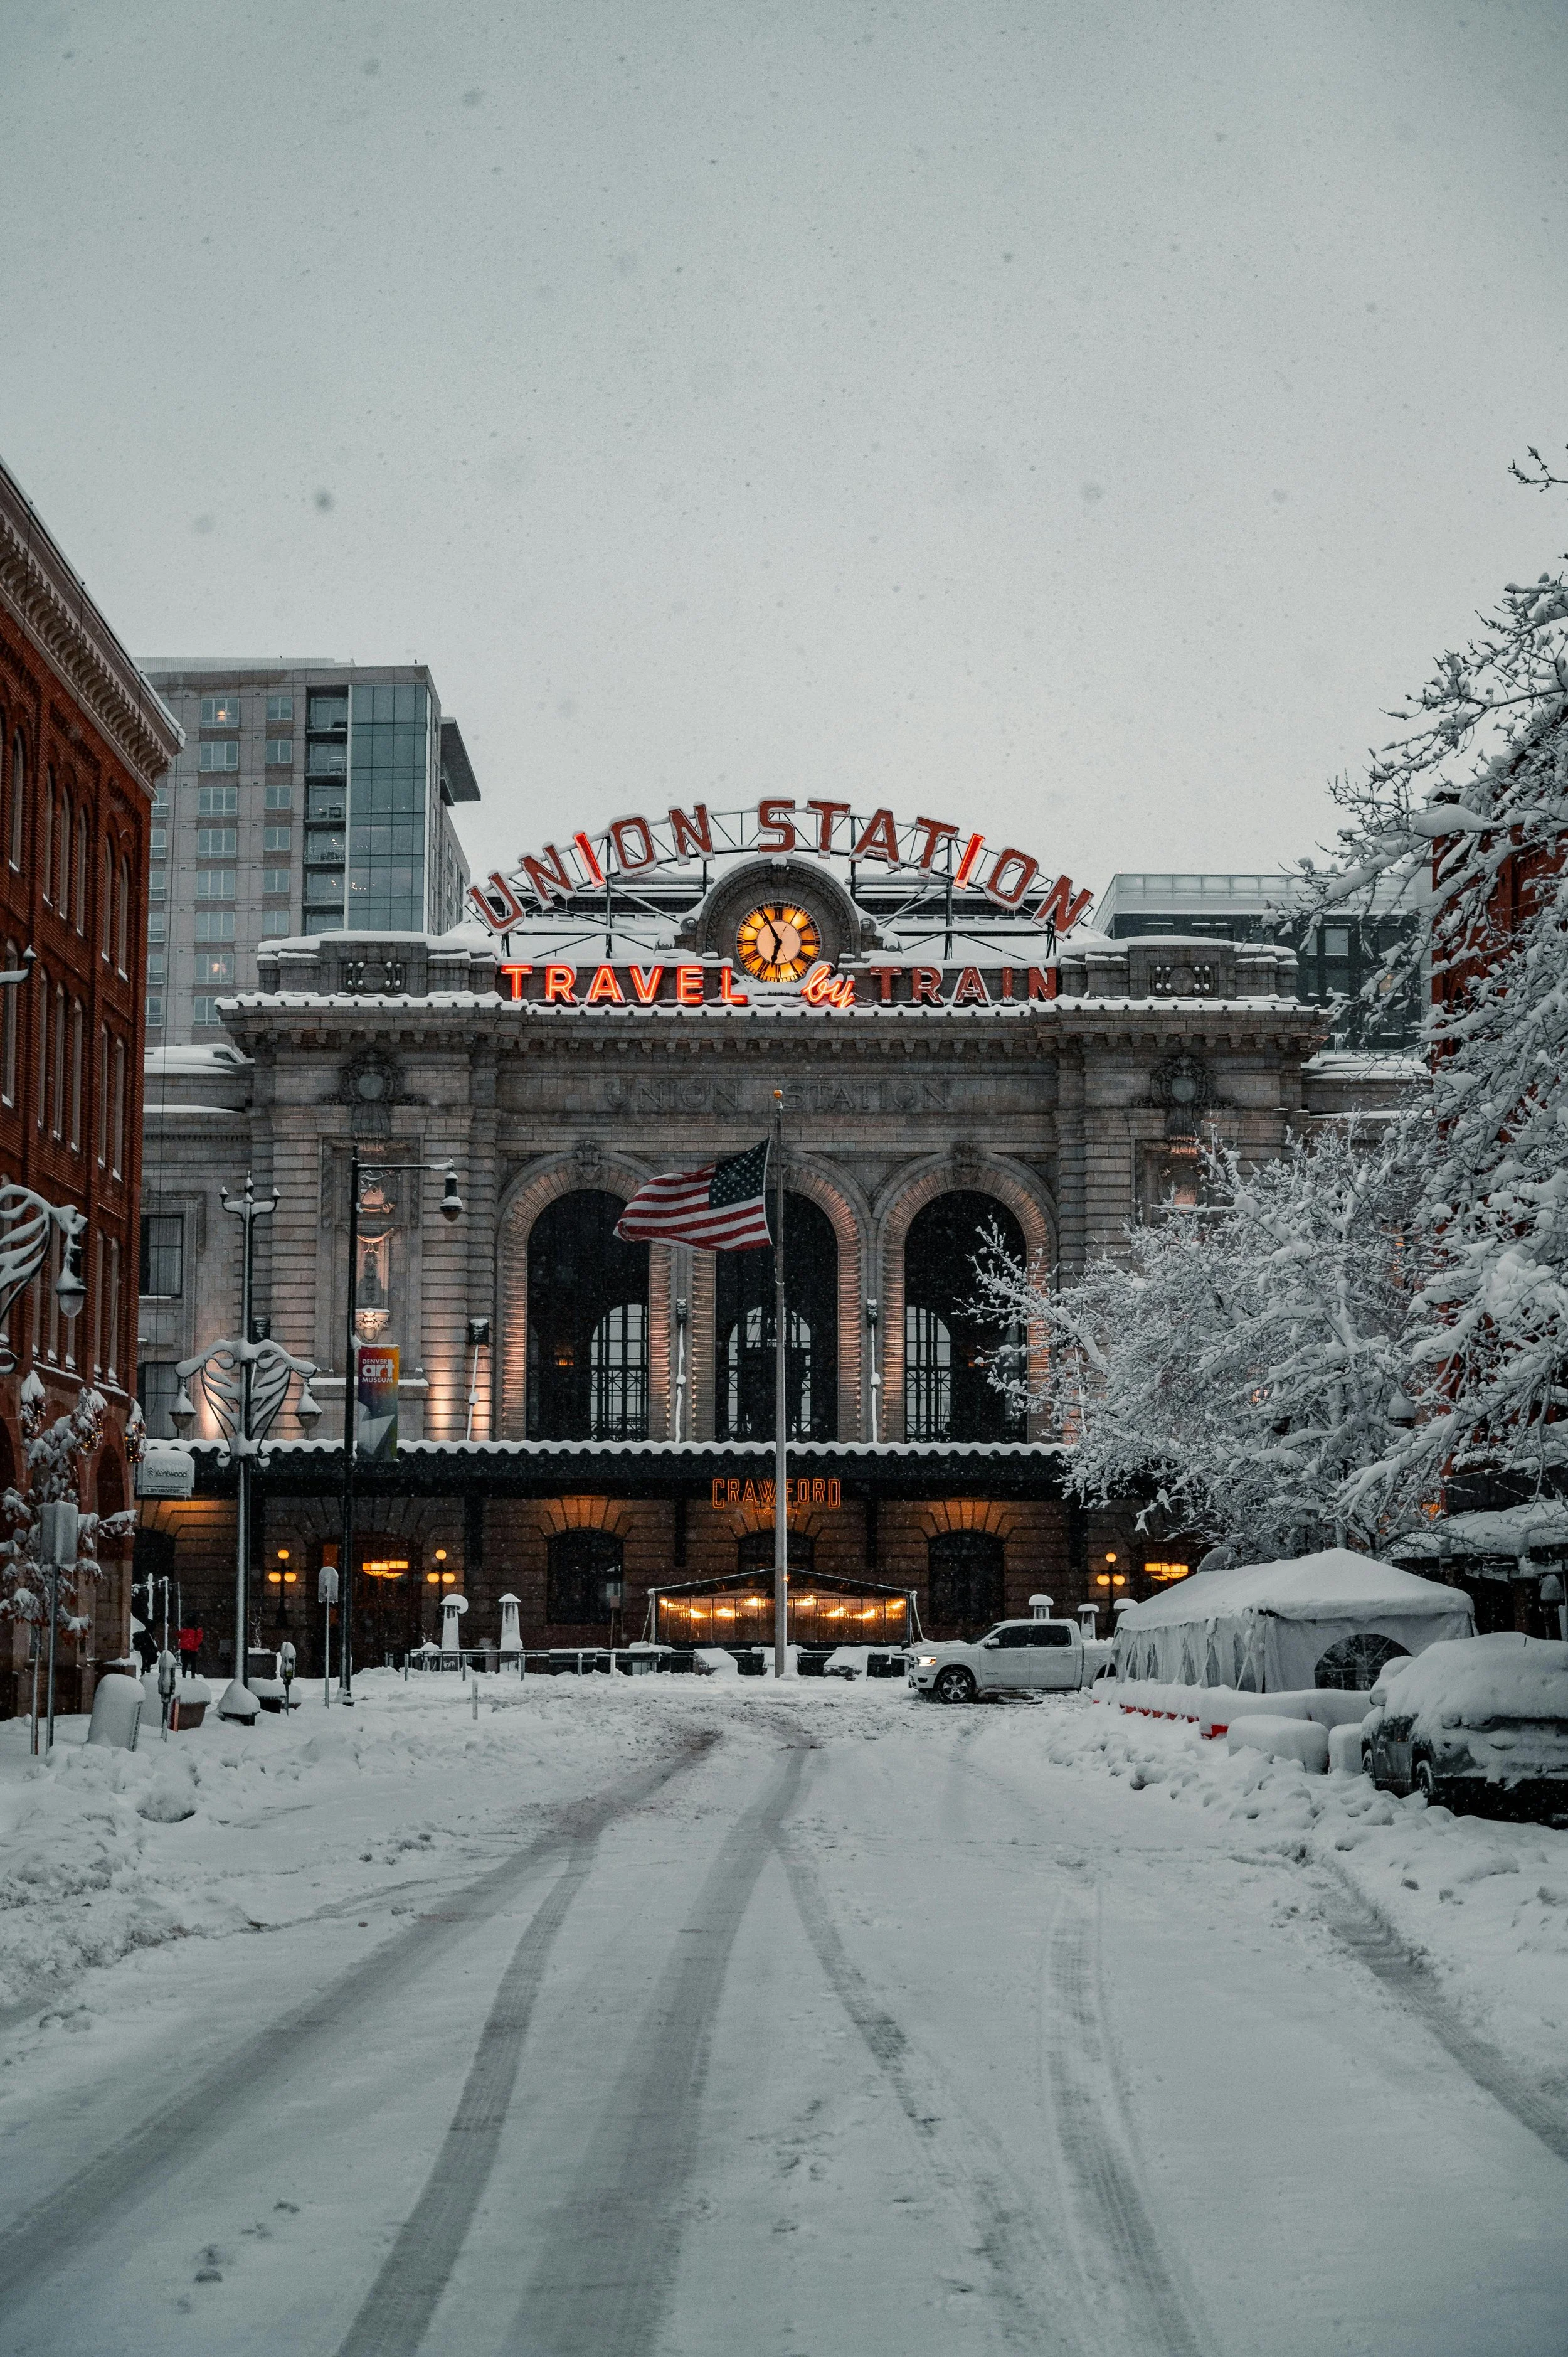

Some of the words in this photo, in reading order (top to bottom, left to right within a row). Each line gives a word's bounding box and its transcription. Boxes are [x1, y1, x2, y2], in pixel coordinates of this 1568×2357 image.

[467, 802, 715, 935] UNION
[757, 799, 1094, 942] STATION
[501, 964, 748, 1004] TRAVEL
[800, 964, 856, 1008] by
[870, 966, 1057, 1004] TRAIN
[605, 1082, 740, 1109] UNION
[783, 1082, 949, 1109] STATION
[362, 1359, 395, 1377] art
[155, 1469, 188, 1478] Kentwood
[712, 1478, 840, 1508] CRAWFORD
[753, 1507, 801, 1515] HOEL
